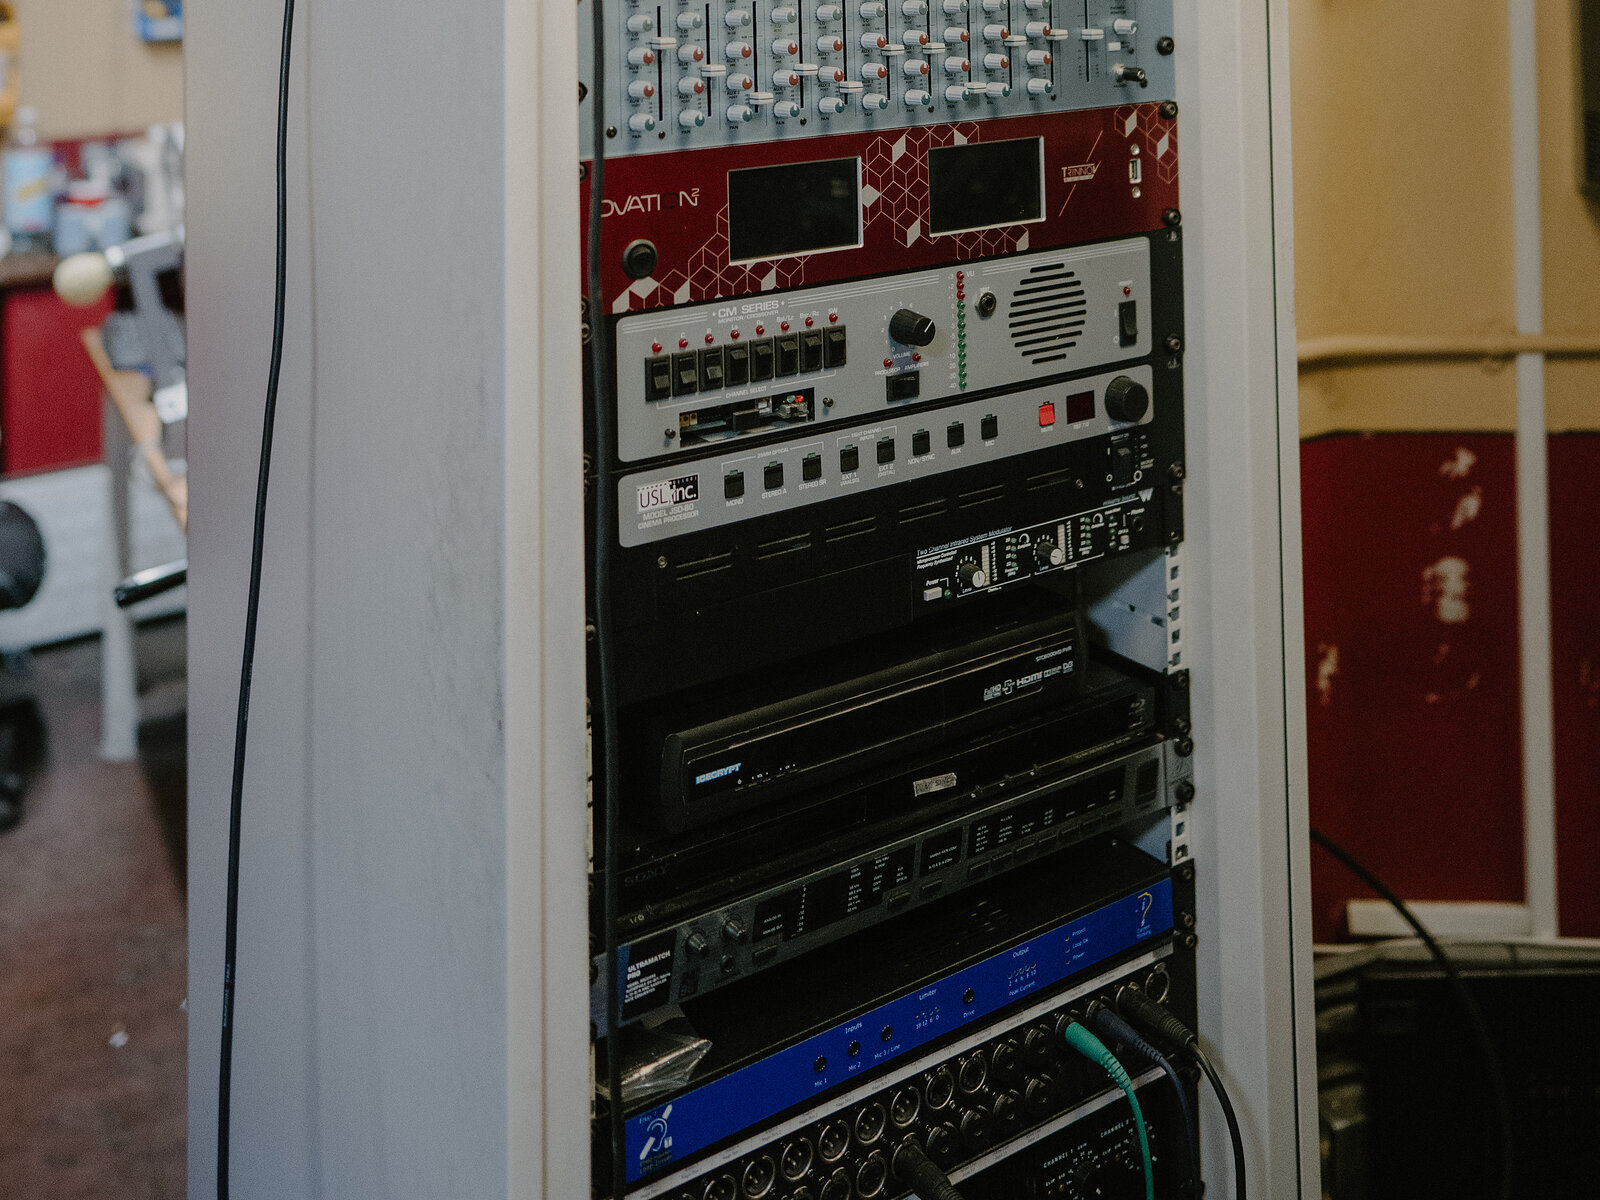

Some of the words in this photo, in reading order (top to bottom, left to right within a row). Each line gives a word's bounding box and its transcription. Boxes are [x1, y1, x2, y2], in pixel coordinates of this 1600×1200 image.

[718, 307, 737, 318] CM
[741, 300, 779, 314] SERIES
[718, 310, 779, 324] MONITOR/CROSSOVER
[875, 366, 901, 376] PROCESSOR
[725, 388, 749, 398] CHANNEL
[750, 385, 767, 395] SELECT
[863, 428, 882, 436] CHANNEL
[772, 448, 790, 456] OPTICAL
[907, 454, 936, 465] NON/SYNC
[799, 482, 819, 490] STEREO
[818, 479, 826, 487] SR
[761, 489, 782, 499] STEREO
[726, 498, 744, 507] MONO
[638, 519, 662, 530] CINEMA
[664, 510, 699, 523] PROCESSOR
[643, 509, 668, 520] MODEL
[928, 542, 949, 553] Channel
[950, 537, 969, 547] Infrared
[970, 532, 988, 543] System
[989, 526, 1013, 537] Modulator
[926, 578, 939, 586] Power
[1017, 671, 1043, 686] HDMI
[696, 762, 742, 785] ICECRYPT
[1072, 927, 1086, 936] Protect
[1072, 941, 1082, 949] Loop
[1013, 947, 1029, 958] Output
[1073, 952, 1085, 960] Power
[628, 950, 671, 972] ULTRAMATCH
[627, 970, 641, 980] PRO
[1020, 981, 1035, 992] Current
[919, 989, 937, 1000] Limiter
[963, 1010, 975, 1018] Drive
[845, 1022, 862, 1034] Inputs
[890, 1044, 901, 1053] Line
[1100, 1122, 1124, 1138] CHANNEL
[1043, 1152, 1069, 1169] CHANNEL
